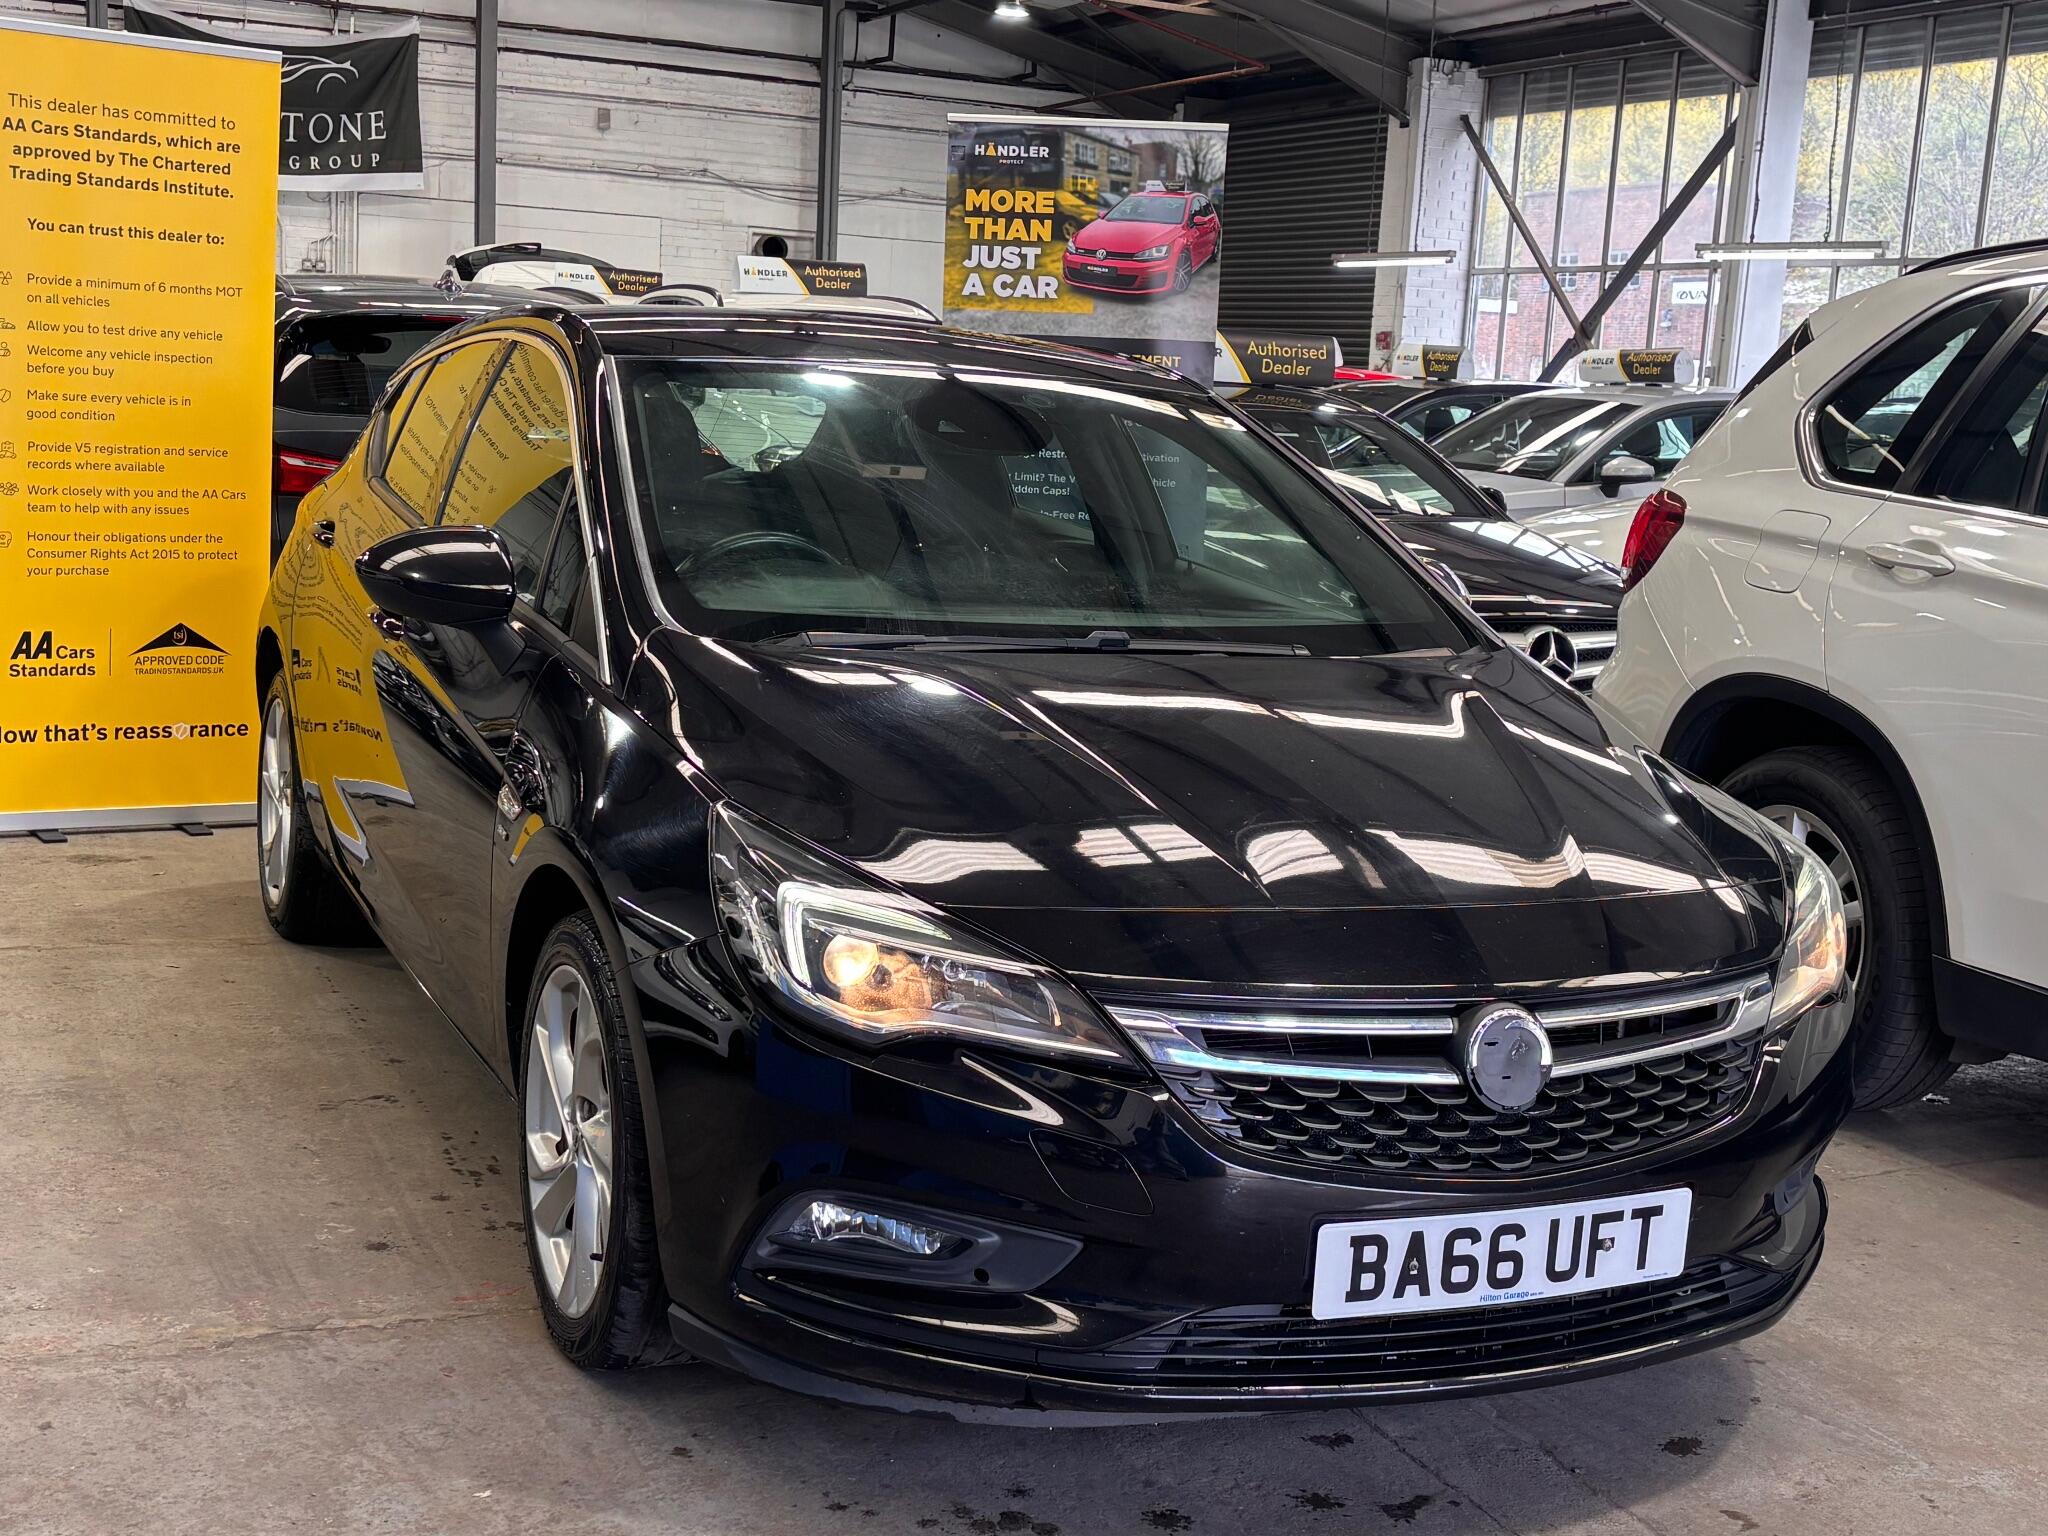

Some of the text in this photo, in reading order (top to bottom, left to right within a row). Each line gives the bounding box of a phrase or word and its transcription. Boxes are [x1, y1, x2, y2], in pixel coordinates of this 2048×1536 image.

[7, 92, 236, 131] This dealer has committed to
[1, 116, 241, 154] AA Cars Standards, which are
[12, 144, 231, 176] approved by The Chartered
[288, 153, 381, 170] GROUP
[8, 164, 234, 199] Trading Standards Institute.
[965, 188, 1055, 214] MORE
[27, 217, 225, 246] You can trust this dealer to:
[964, 216, 1053, 242] THAN
[962, 244, 1042, 270] JUST
[608, 270, 658, 284] Authorised
[804, 265, 862, 279] Authorised
[27, 272, 244, 298] Provide a minimum of 6 months MOT
[617, 280, 648, 292] Dealer
[815, 277, 852, 290] Dealer
[961, 273, 1059, 299] A CAR
[26, 293, 111, 308] on all vehicles
[26, 319, 224, 342] Allow you to test drive any vehicle
[26, 344, 213, 365] Welcome any vehicle inspection
[1247, 340, 1328, 360] Authorised
[1626, 351, 1674, 362] Authorised
[26, 362, 115, 379] before you buy
[1261, 359, 1312, 376] Dealer
[1632, 363, 1661, 375] Dealer
[27, 389, 192, 407] Make sure every vehicle is in
[26, 408, 115, 422] good condition
[27, 440, 229, 458] Provide V5 registration and service
[27, 459, 165, 473] records where available
[1014, 471, 1046, 482] Limit?
[1048, 473, 1066, 483] The
[27, 484, 247, 500] Work closely with you and the AA Cars
[1042, 486, 1070, 496] Caps!
[27, 502, 190, 517] team to help with any issues
[27, 530, 224, 545] Honour their obligations under the
[26, 547, 238, 561] Consumer Rights Act 2015 to protect
[26, 565, 110, 578] your purchase
[11, 631, 95, 660] AA Cars
[134, 655, 225, 666] APPROVED CODE
[9, 662, 96, 678] Standards
[134, 666, 224, 675] TRADINGSTANDARDS.UK
[0, 728, 38, 743] ow
[44, 722, 108, 742] that's
[1344, 1204, 1664, 1303] BA66 UFT
[1479, 1292, 1502, 1303] Hilton
[1503, 1291, 1530, 1301] Garage
